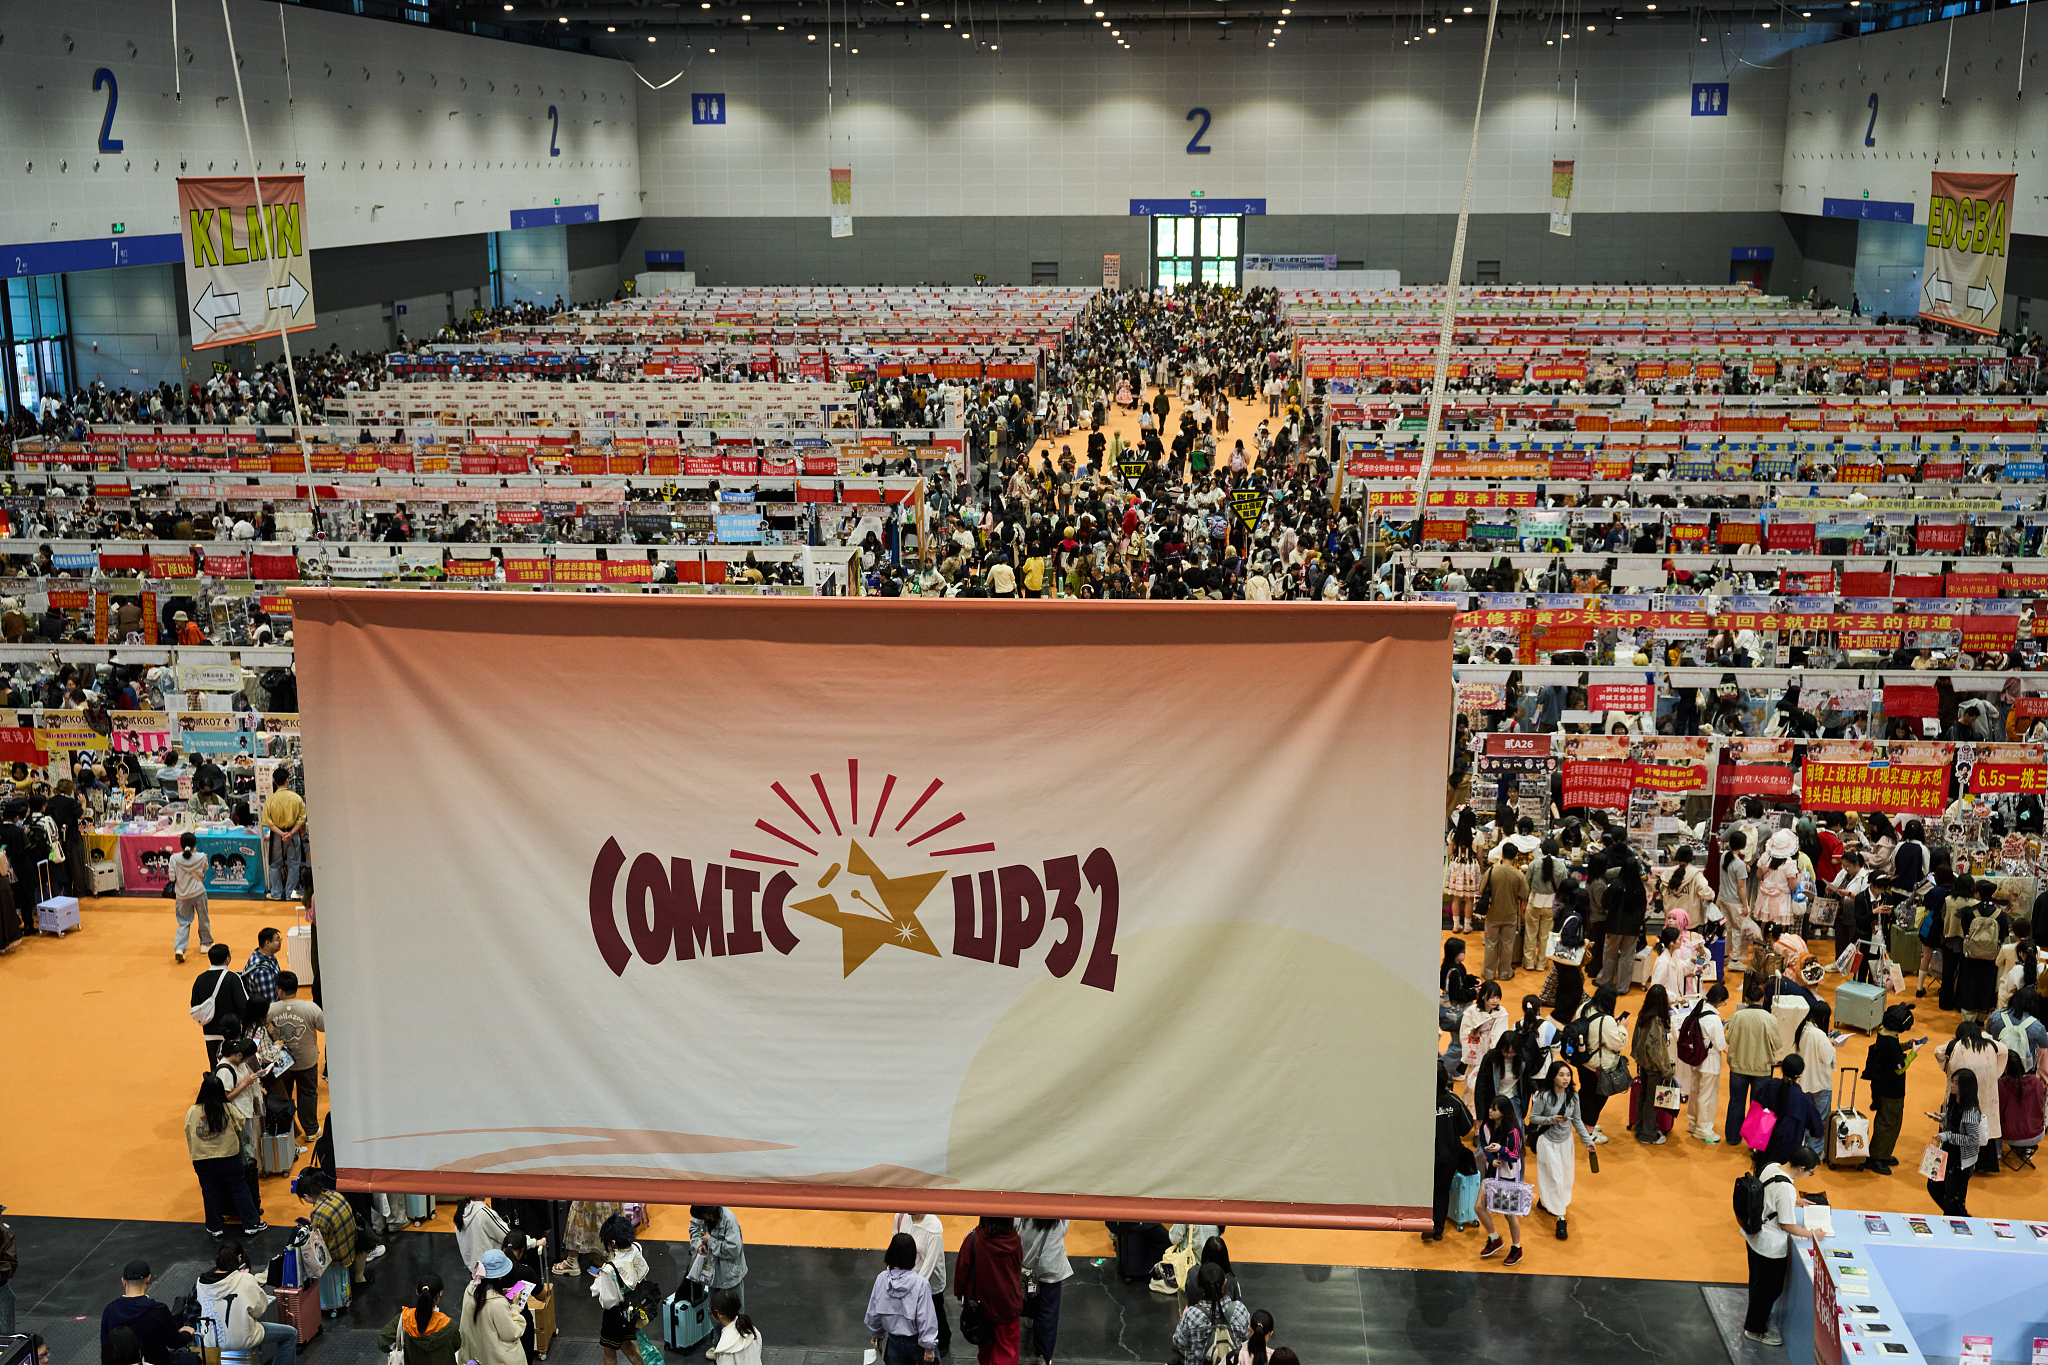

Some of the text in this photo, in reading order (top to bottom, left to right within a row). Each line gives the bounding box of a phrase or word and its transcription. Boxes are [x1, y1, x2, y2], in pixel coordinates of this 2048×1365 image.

[93, 67, 124, 154] 2
[1865, 92, 1878, 146] 2
[547, 105, 560, 156] 2
[1186, 107, 1212, 154] 2
[1139, 205, 1145, 214] 2
[1189, 200, 1197, 214] 5
[1245, 205, 1251, 214] 2
[189, 202, 303, 268] KLMN
[1927, 195, 2006, 258] EDCBA
[15, 256, 22, 273] 2
[111, 242, 119, 265] 7
[1124, 465, 1142, 477] 隊尾
[128, 716, 155, 726] 贰K08
[195, 717, 221, 727] 贰K07
[1805, 763, 1943, 787] 网络上说说得了现实里谁不想
[1803, 784, 1941, 809] 急头白脸地摸摸叶修的四个奖杯
[589, 835, 1120, 992] COMIC UP32
